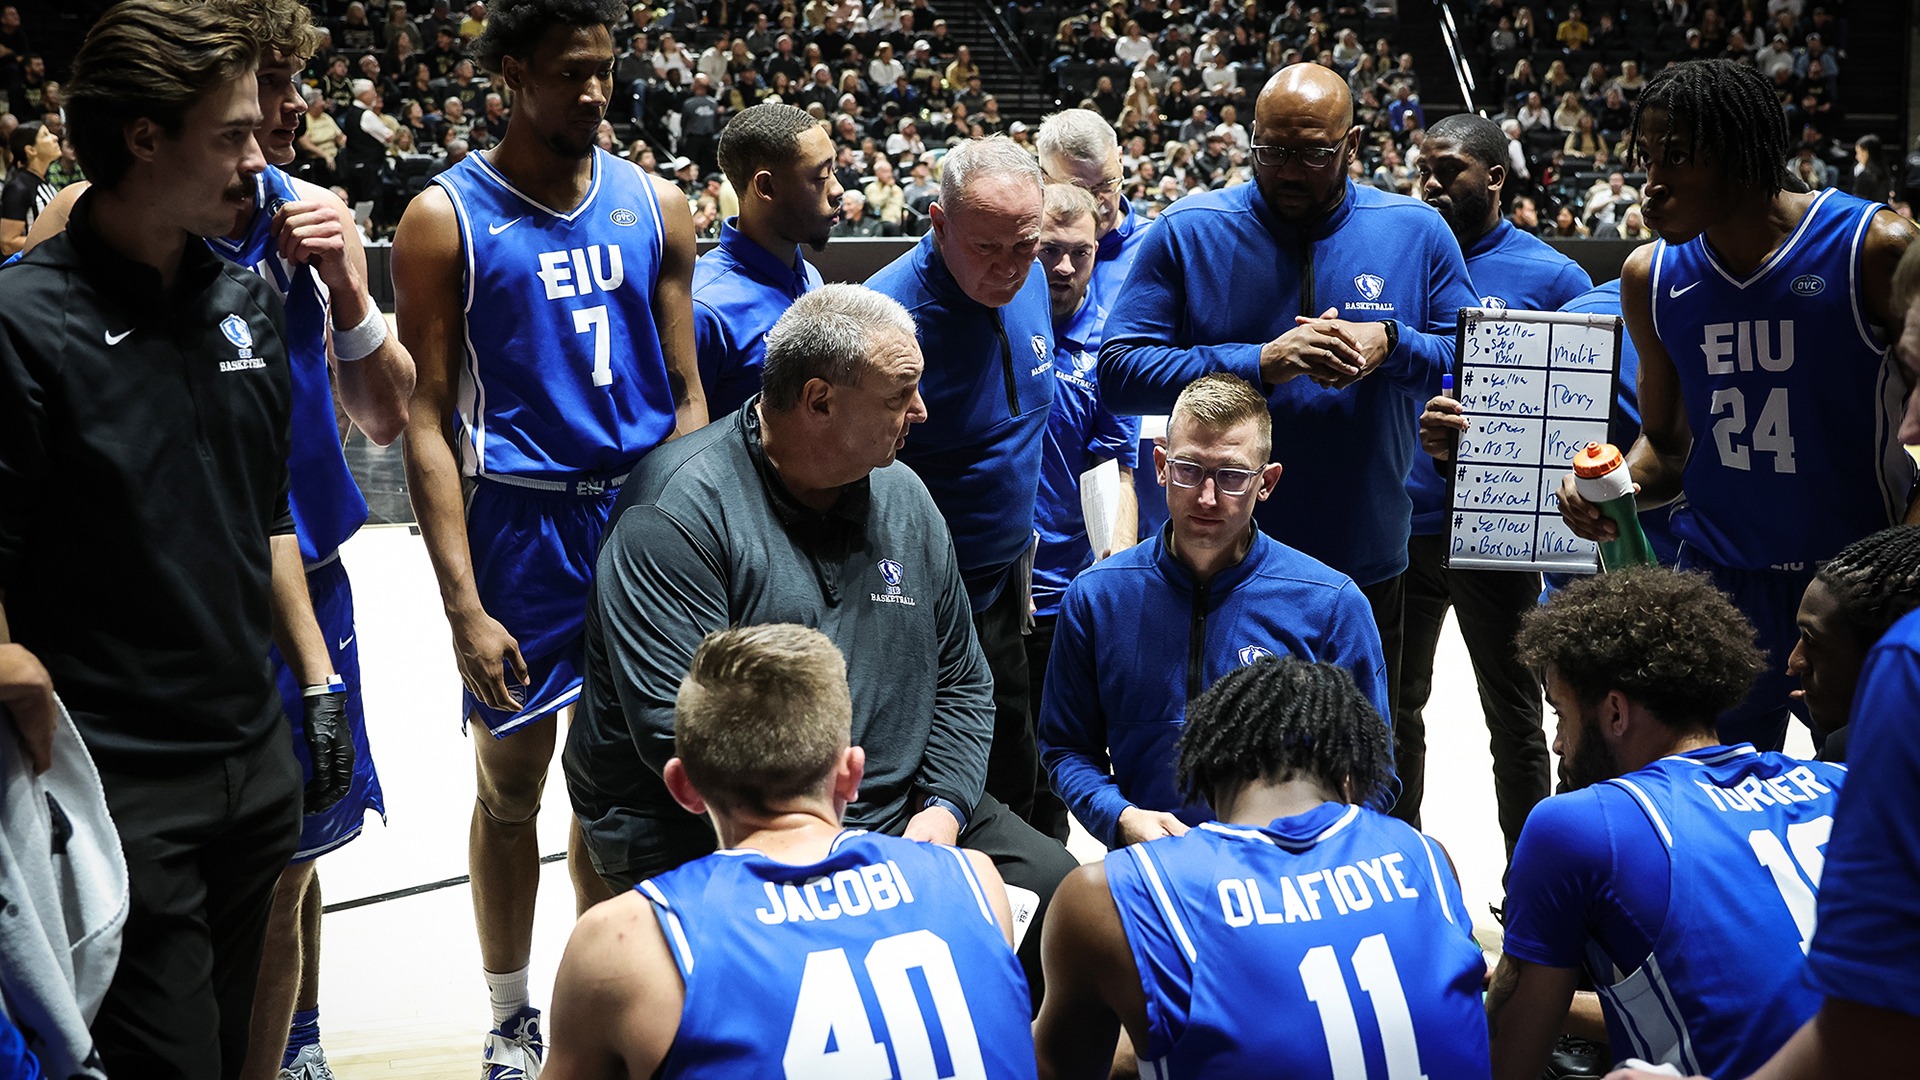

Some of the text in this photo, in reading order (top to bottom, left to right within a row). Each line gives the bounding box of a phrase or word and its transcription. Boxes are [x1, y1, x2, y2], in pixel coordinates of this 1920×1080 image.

[536, 244, 624, 301] EIU
[1797, 281, 1817, 290] OVC
[1344, 302, 1395, 311] BASKETBALL
[571, 304, 613, 387] 7
[1700, 319, 1795, 375] EIU
[1458, 440, 1474, 458] 2
[1710, 387, 1796, 473] 24
[870, 593, 916, 606] BASKETBALL
[755, 859, 915, 925] JACOBI
[1216, 852, 1420, 929] OLAFIOYE
[781, 928, 989, 1080] 40
[1298, 932, 1430, 1080] 11
